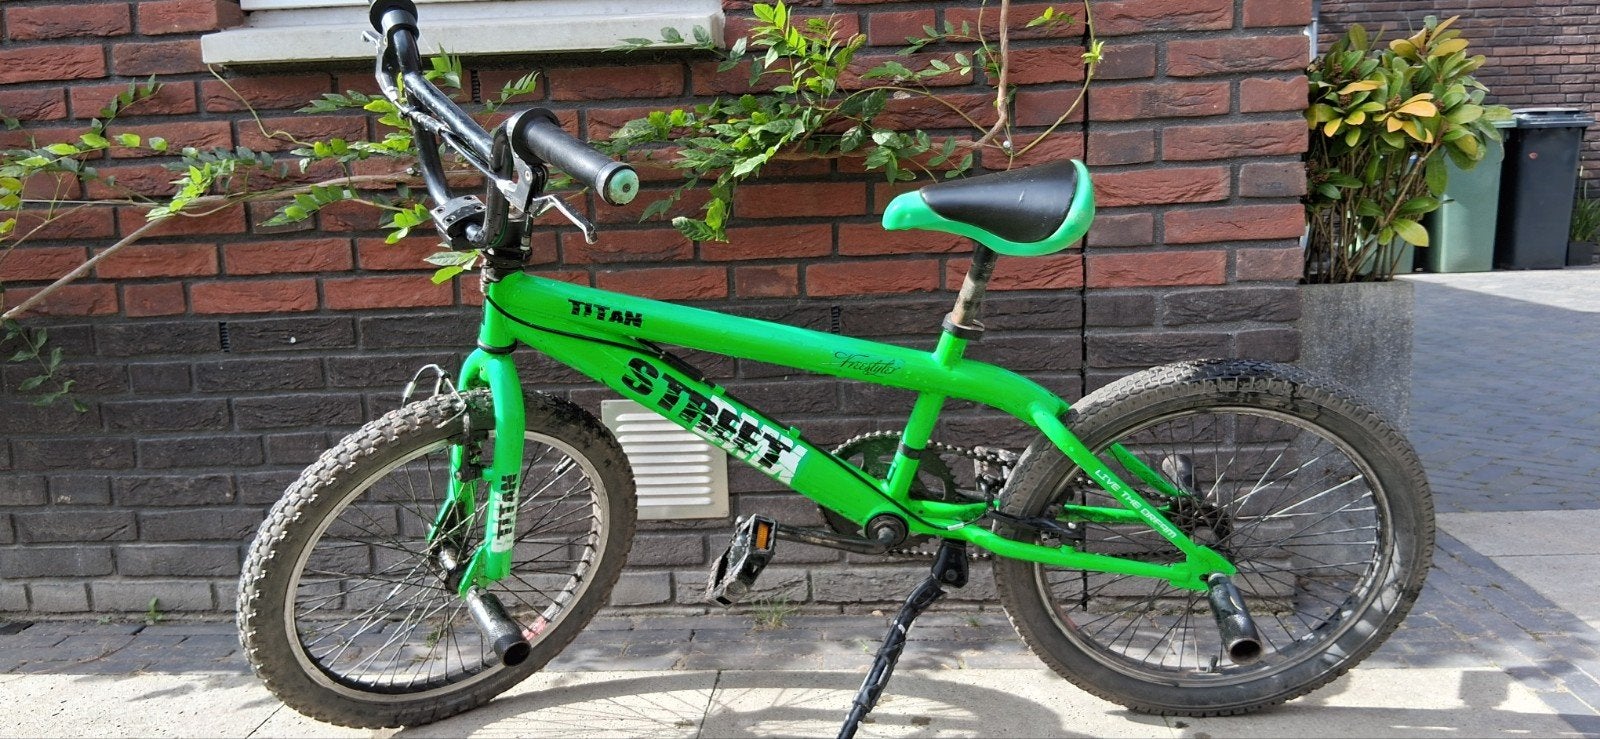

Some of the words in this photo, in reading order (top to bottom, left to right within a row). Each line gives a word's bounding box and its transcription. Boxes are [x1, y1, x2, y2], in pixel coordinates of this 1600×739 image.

[567, 298, 642, 328] TITAN
[621, 357, 793, 469] STREET
[497, 473, 517, 540] TITAN
[1095, 469, 1121, 491] LIVE
[1121, 491, 1142, 509] THE
[1140, 508, 1177, 538] DREAM
